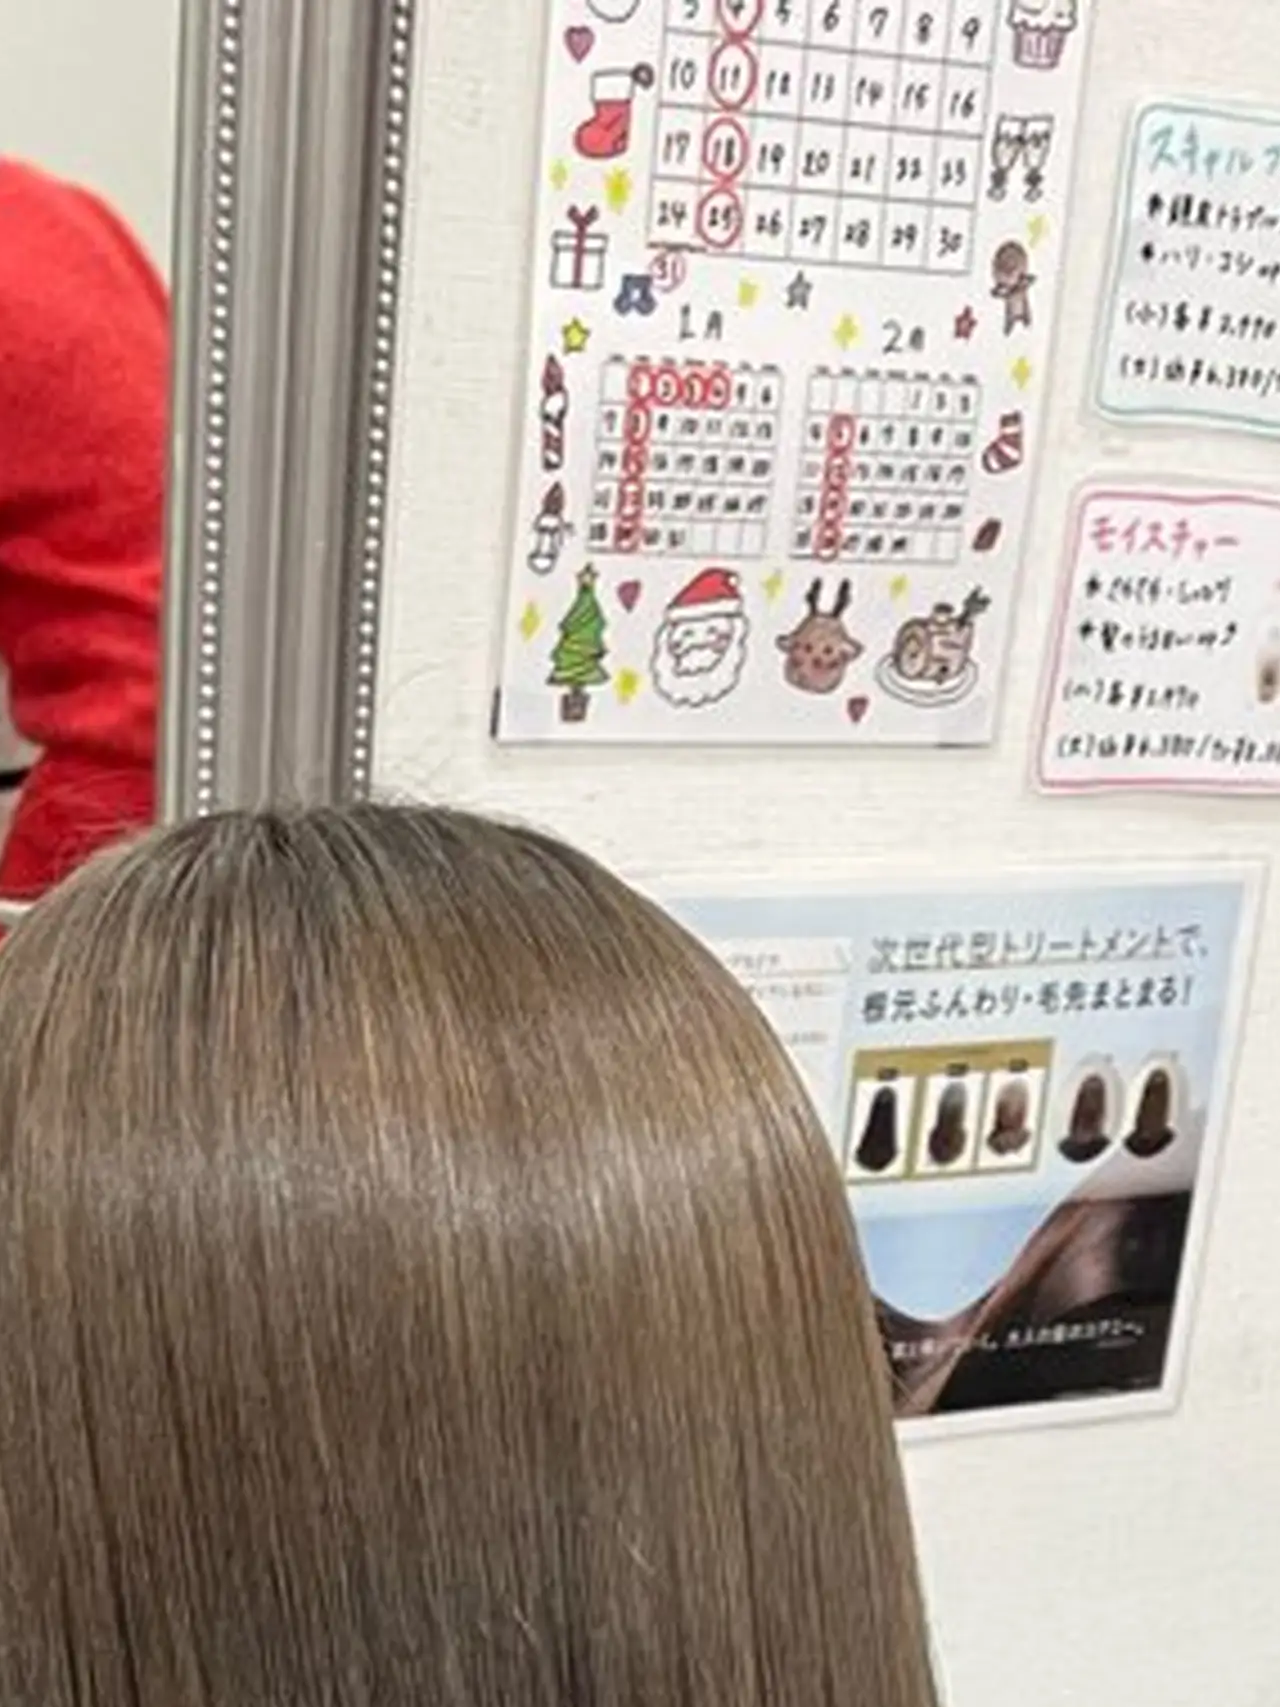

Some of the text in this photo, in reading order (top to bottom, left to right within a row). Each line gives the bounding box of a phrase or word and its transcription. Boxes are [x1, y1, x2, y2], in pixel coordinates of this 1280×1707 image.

[822, 3, 841, 32] 6
[869, 7, 889, 38] 7
[917, 12, 934, 46] 8
[961, 16, 982, 49] 9
[669, 57, 697, 90] 10
[718, 63, 742, 93] 11
[810, 72, 835, 104] 13
[854, 76, 884, 108] 14
[901, 82, 931, 110] 15
[949, 89, 976, 119] 16
[662, 130, 691, 164] 17
[711, 135, 736, 170] 18
[756, 143, 786, 175] 19
[801, 149, 831, 178] 20
[849, 155, 877, 183] 21
[895, 156, 922, 183] 22
[657, 199, 963, 258] 24 25 26 27 28 29 30
[1090, 515, 1240, 561] モイスチャー
[868, 922, 1209, 974] 次世代型トリートメントで、
